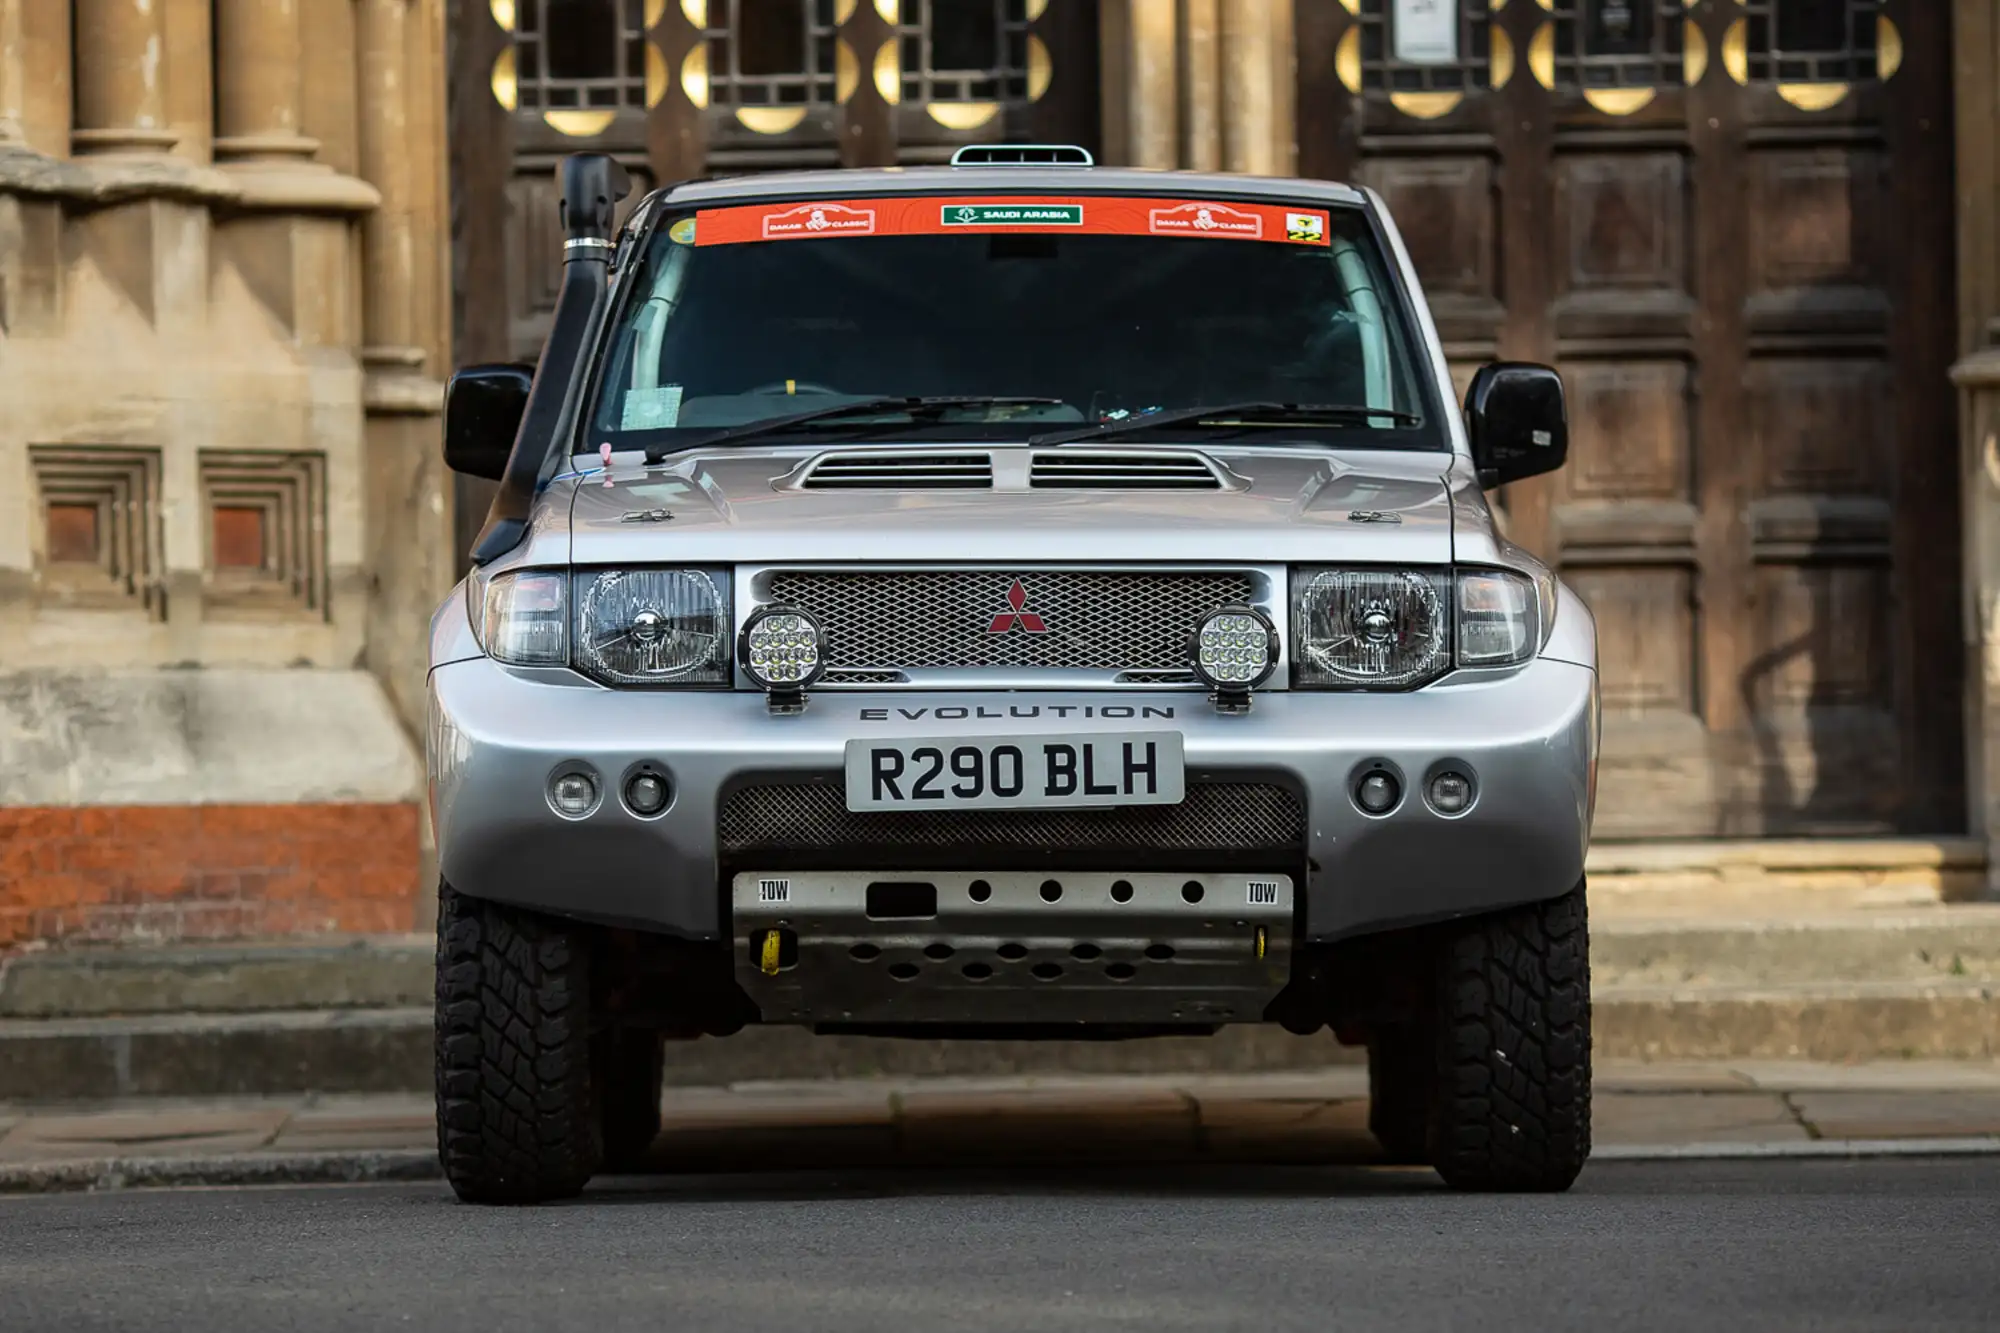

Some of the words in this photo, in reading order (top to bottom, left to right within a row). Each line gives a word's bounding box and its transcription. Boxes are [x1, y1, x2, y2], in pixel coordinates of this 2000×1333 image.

[983, 211, 1021, 219] SAUDI
[1022, 211, 1071, 219] ARABIA
[769, 223, 802, 231] DAKAR
[831, 220, 869, 228] CLASSIC
[859, 706, 1175, 721] EVOLUTION
[870, 745, 1024, 801] R290
[1043, 741, 1157, 797] BLH
[760, 880, 789, 901] TOW
[1248, 883, 1277, 903] TOW
